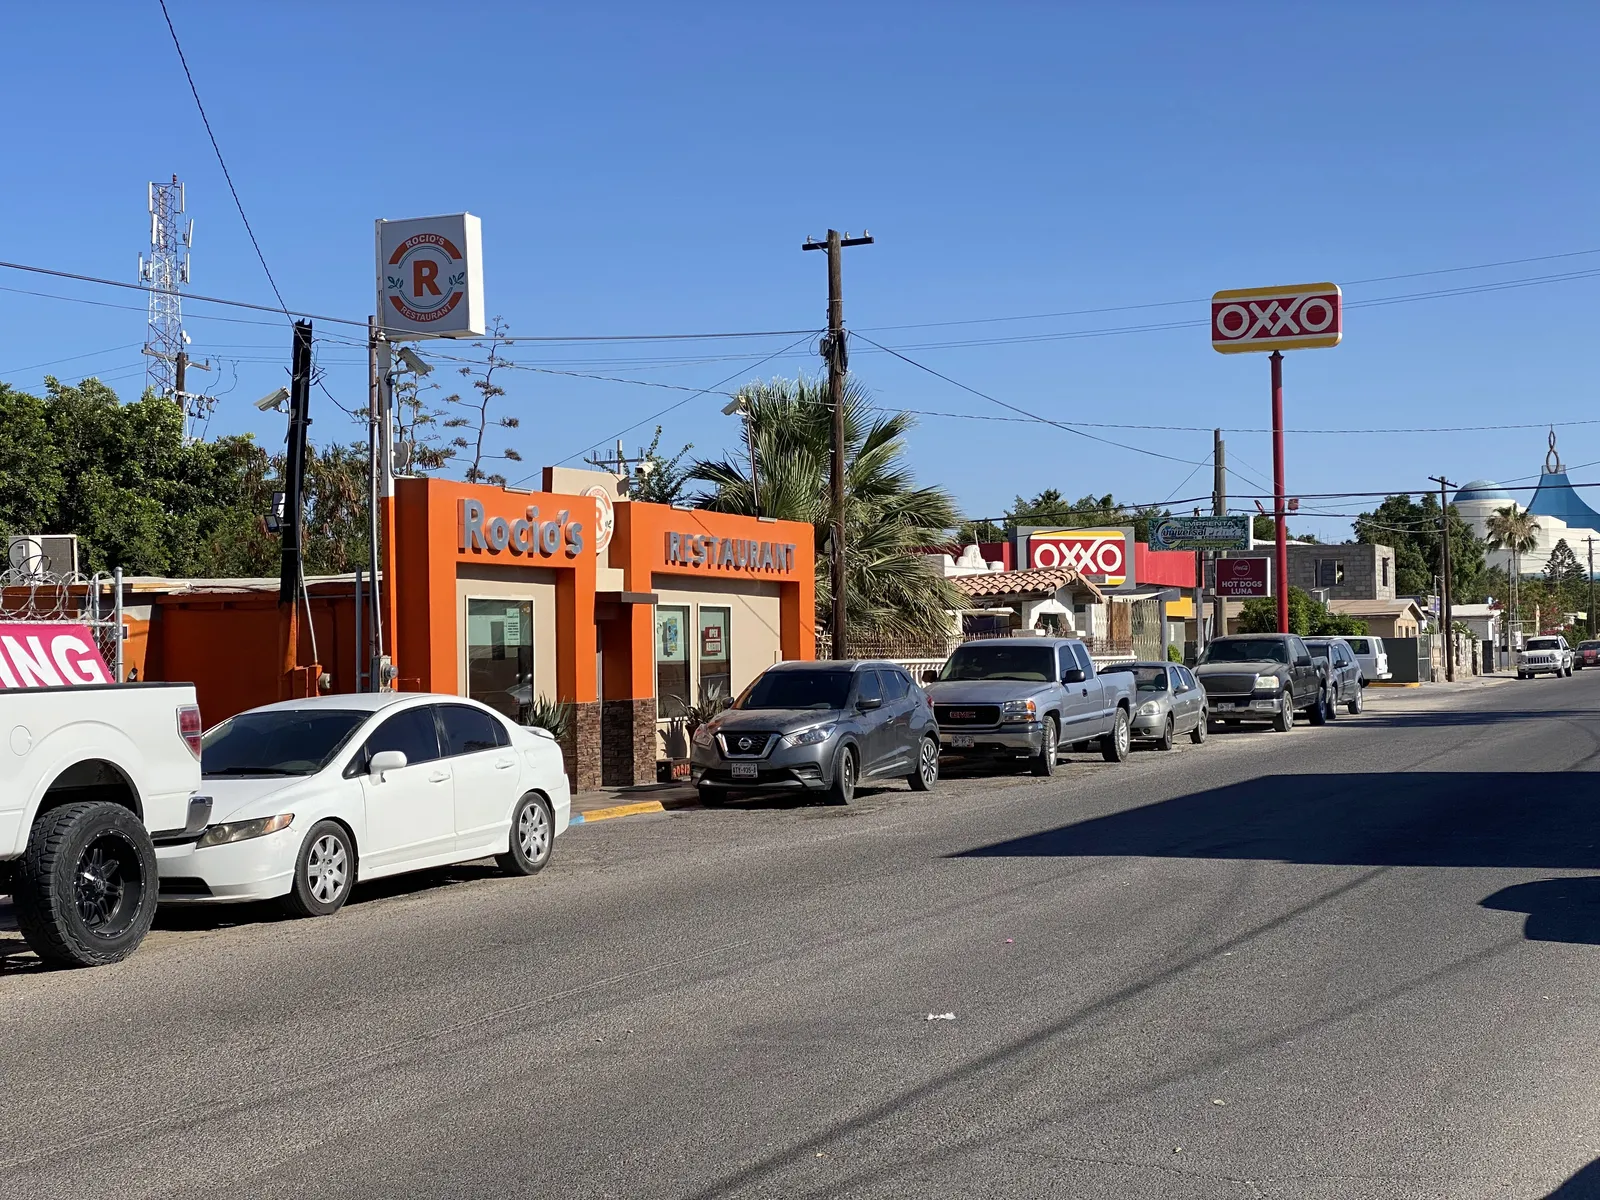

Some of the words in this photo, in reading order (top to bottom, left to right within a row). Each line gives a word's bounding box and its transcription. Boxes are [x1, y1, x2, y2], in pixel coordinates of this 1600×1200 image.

[404, 234, 445, 248] ROCIO'S
[413, 259, 442, 297] R
[400, 303, 452, 321] RESTAURANT
[1216, 295, 1333, 339] OXXO
[457, 498, 583, 555] Rocio's
[664, 531, 796, 571] RESTAURANT
[1034, 541, 1122, 573] OXXO
[1221, 580, 1239, 588] HOT
[1239, 580, 1263, 588] DOGS
[950, 711, 976, 719] GMC
